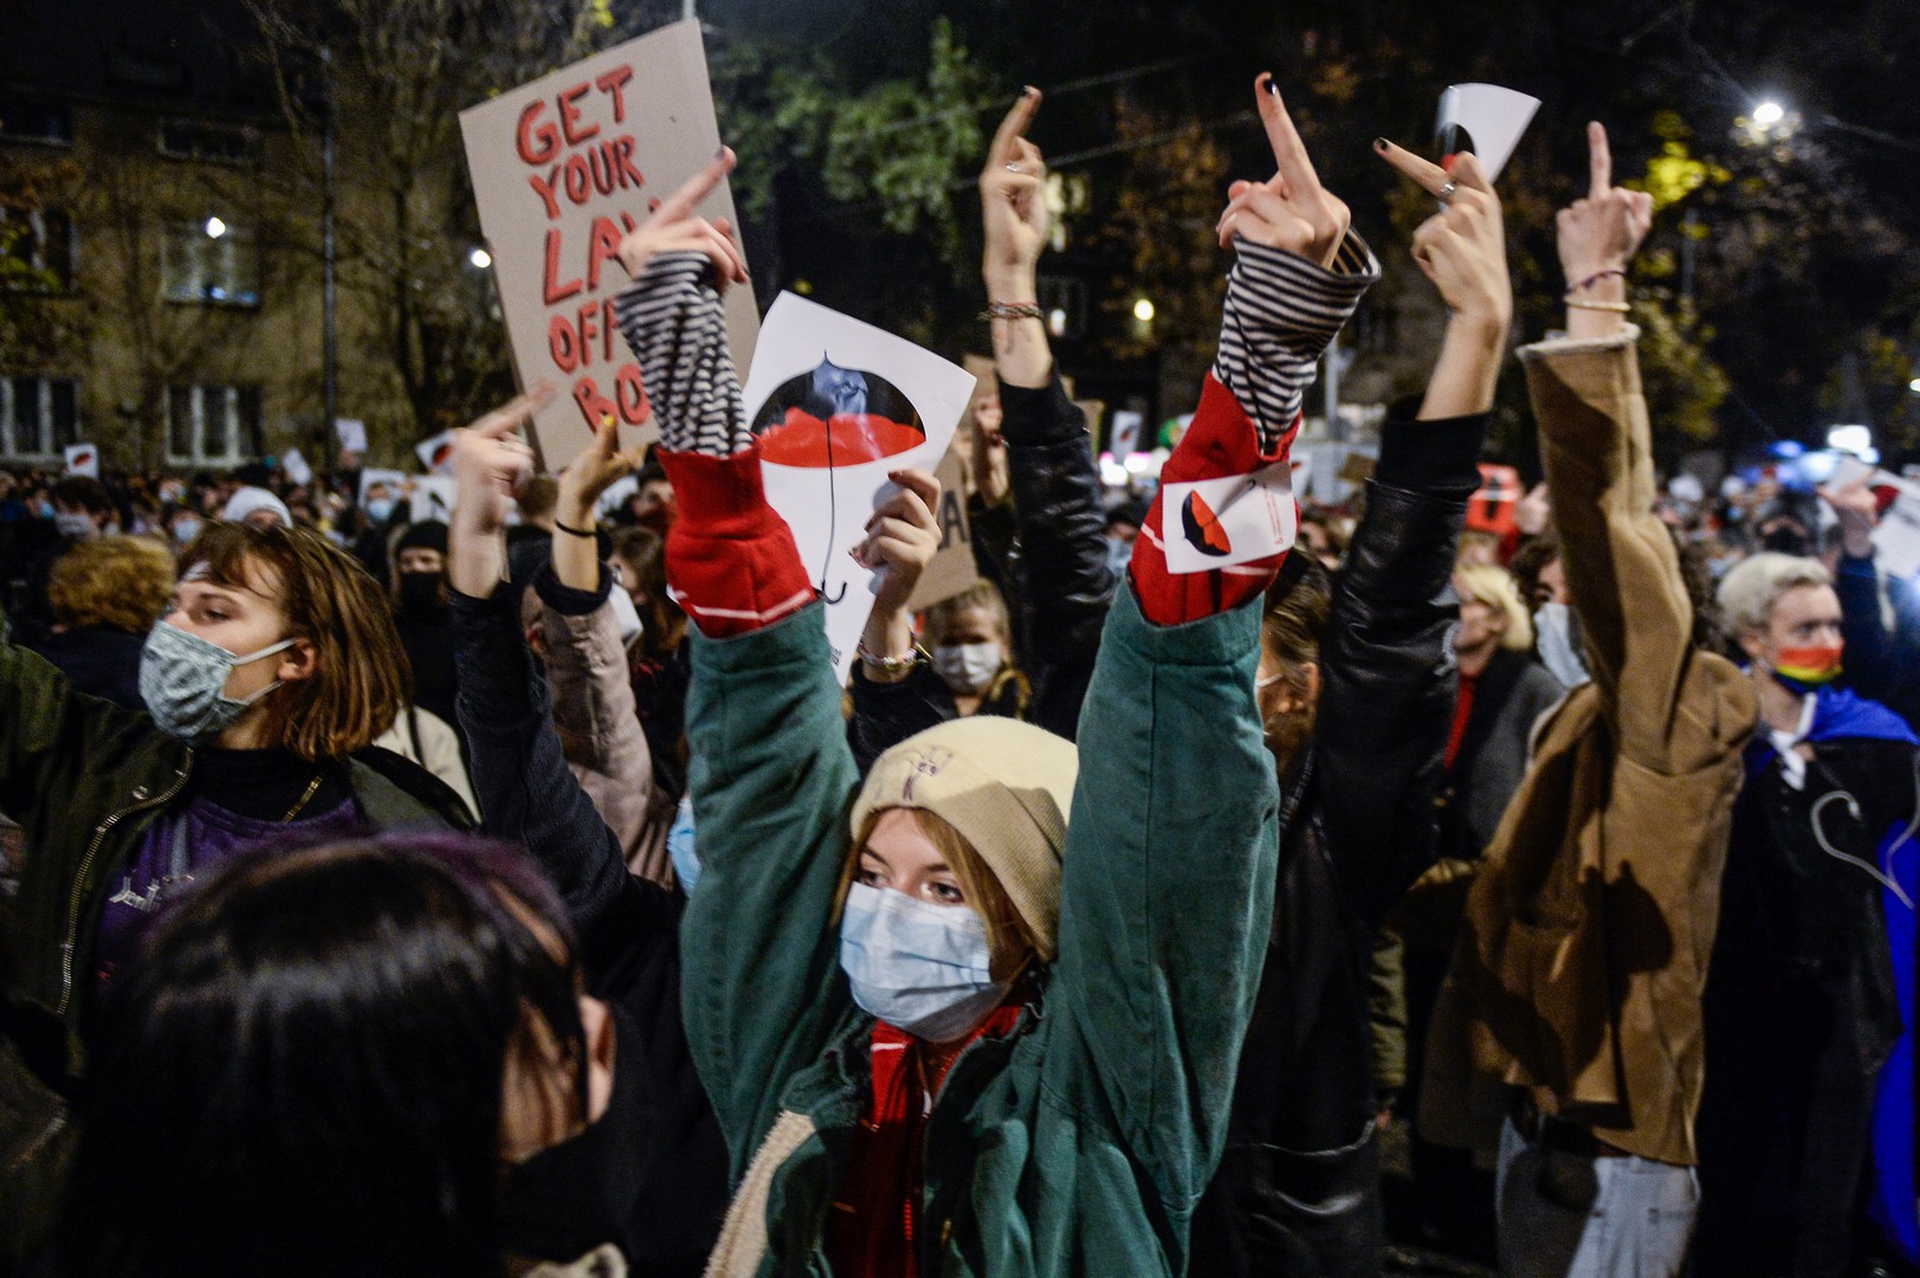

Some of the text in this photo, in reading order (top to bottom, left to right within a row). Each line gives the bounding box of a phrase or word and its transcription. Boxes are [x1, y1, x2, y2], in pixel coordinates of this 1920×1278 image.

[515, 63, 635, 167] GET
[527, 134, 645, 219] YOUR
[543, 197, 662, 306] LA
[573, 363, 650, 435] BO
